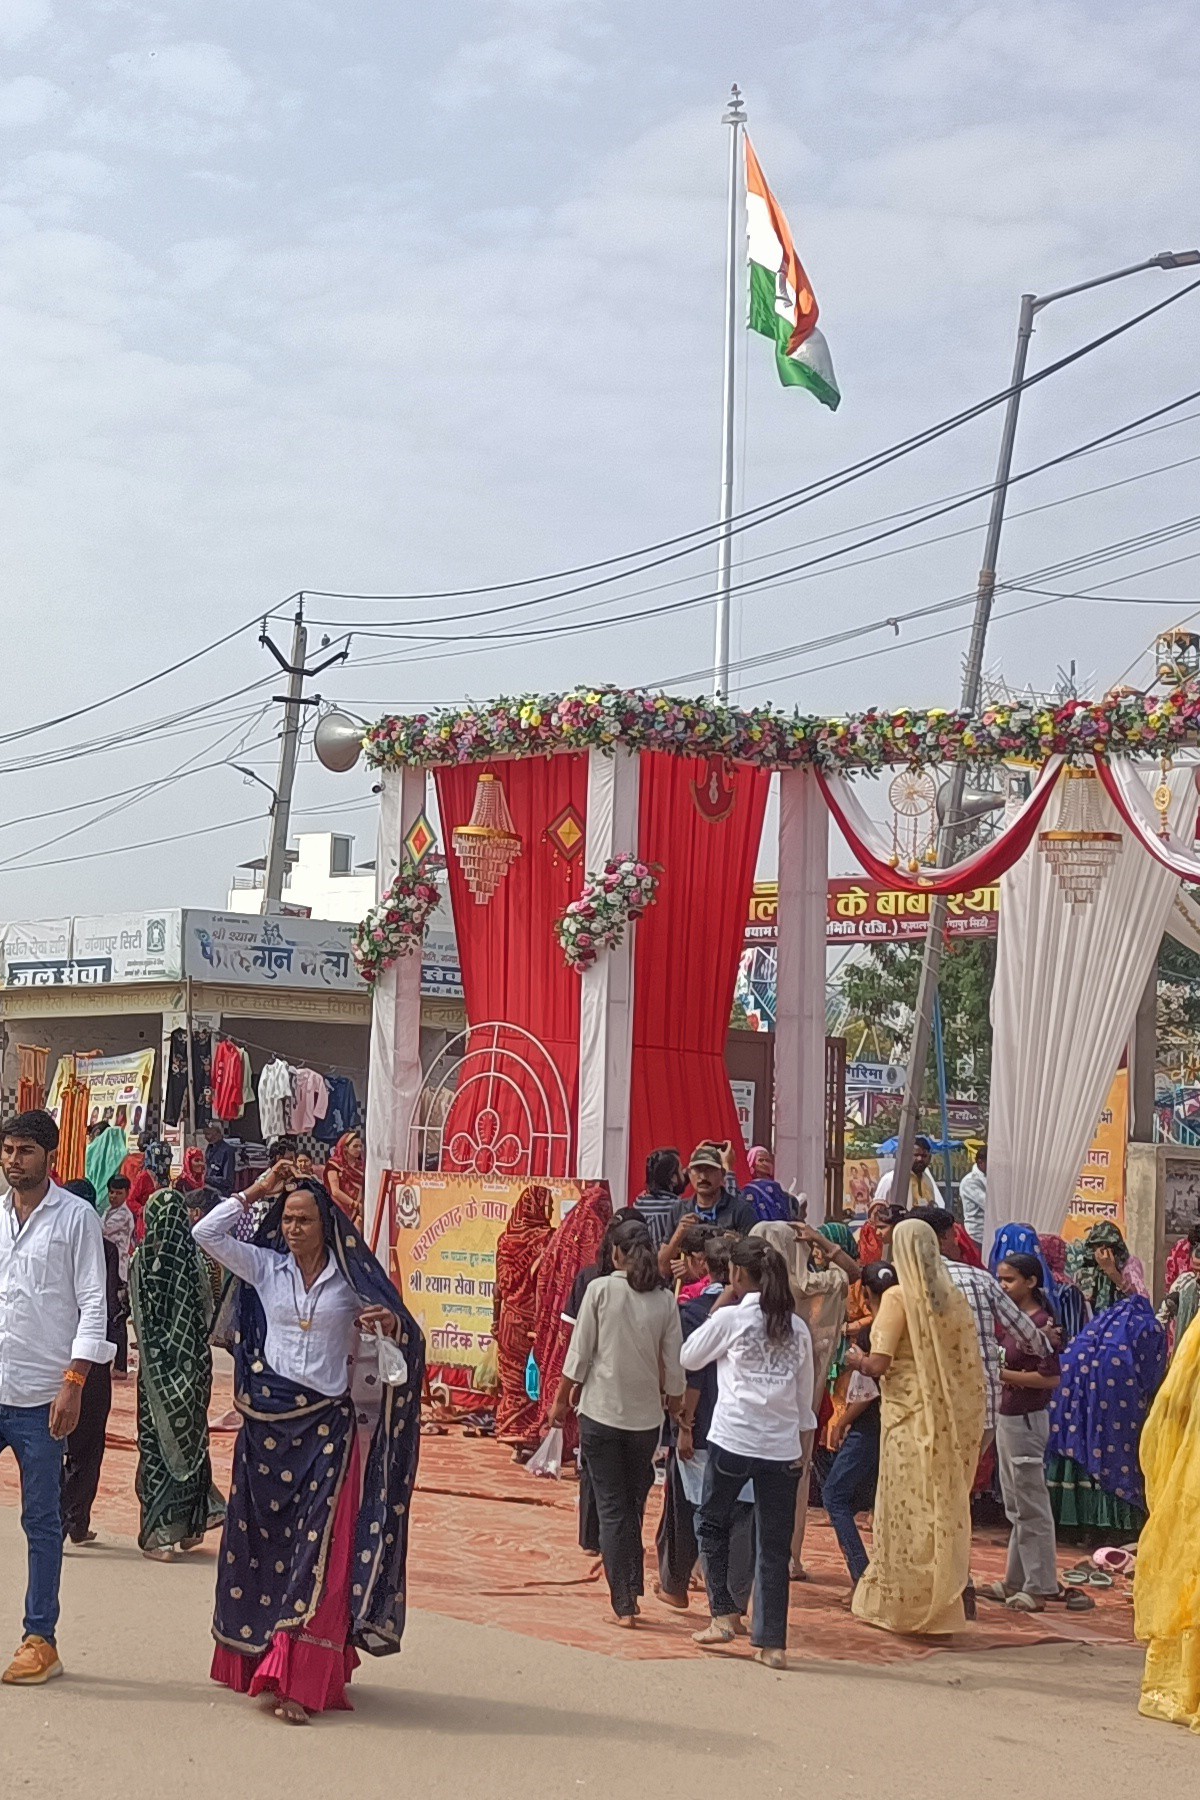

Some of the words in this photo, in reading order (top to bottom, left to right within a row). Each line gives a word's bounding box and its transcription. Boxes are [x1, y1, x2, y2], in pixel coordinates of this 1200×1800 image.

[837, 886, 869, 917] के
[947, 886, 1001, 915] श्या
[120, 930, 143, 950] सिटी
[212, 927, 227, 941] श्री
[228, 931, 258, 943] श्याम
[328, 996, 370, 1016] विधान
[465, 1196, 479, 1219] के
[410, 1269, 422, 1292] श्री
[425, 1276, 452, 1295] श्याम
[454, 1272, 476, 1296] सेवा
[478, 1280, 495, 1298] धा
[430, 1322, 474, 1352] हार्दिक
